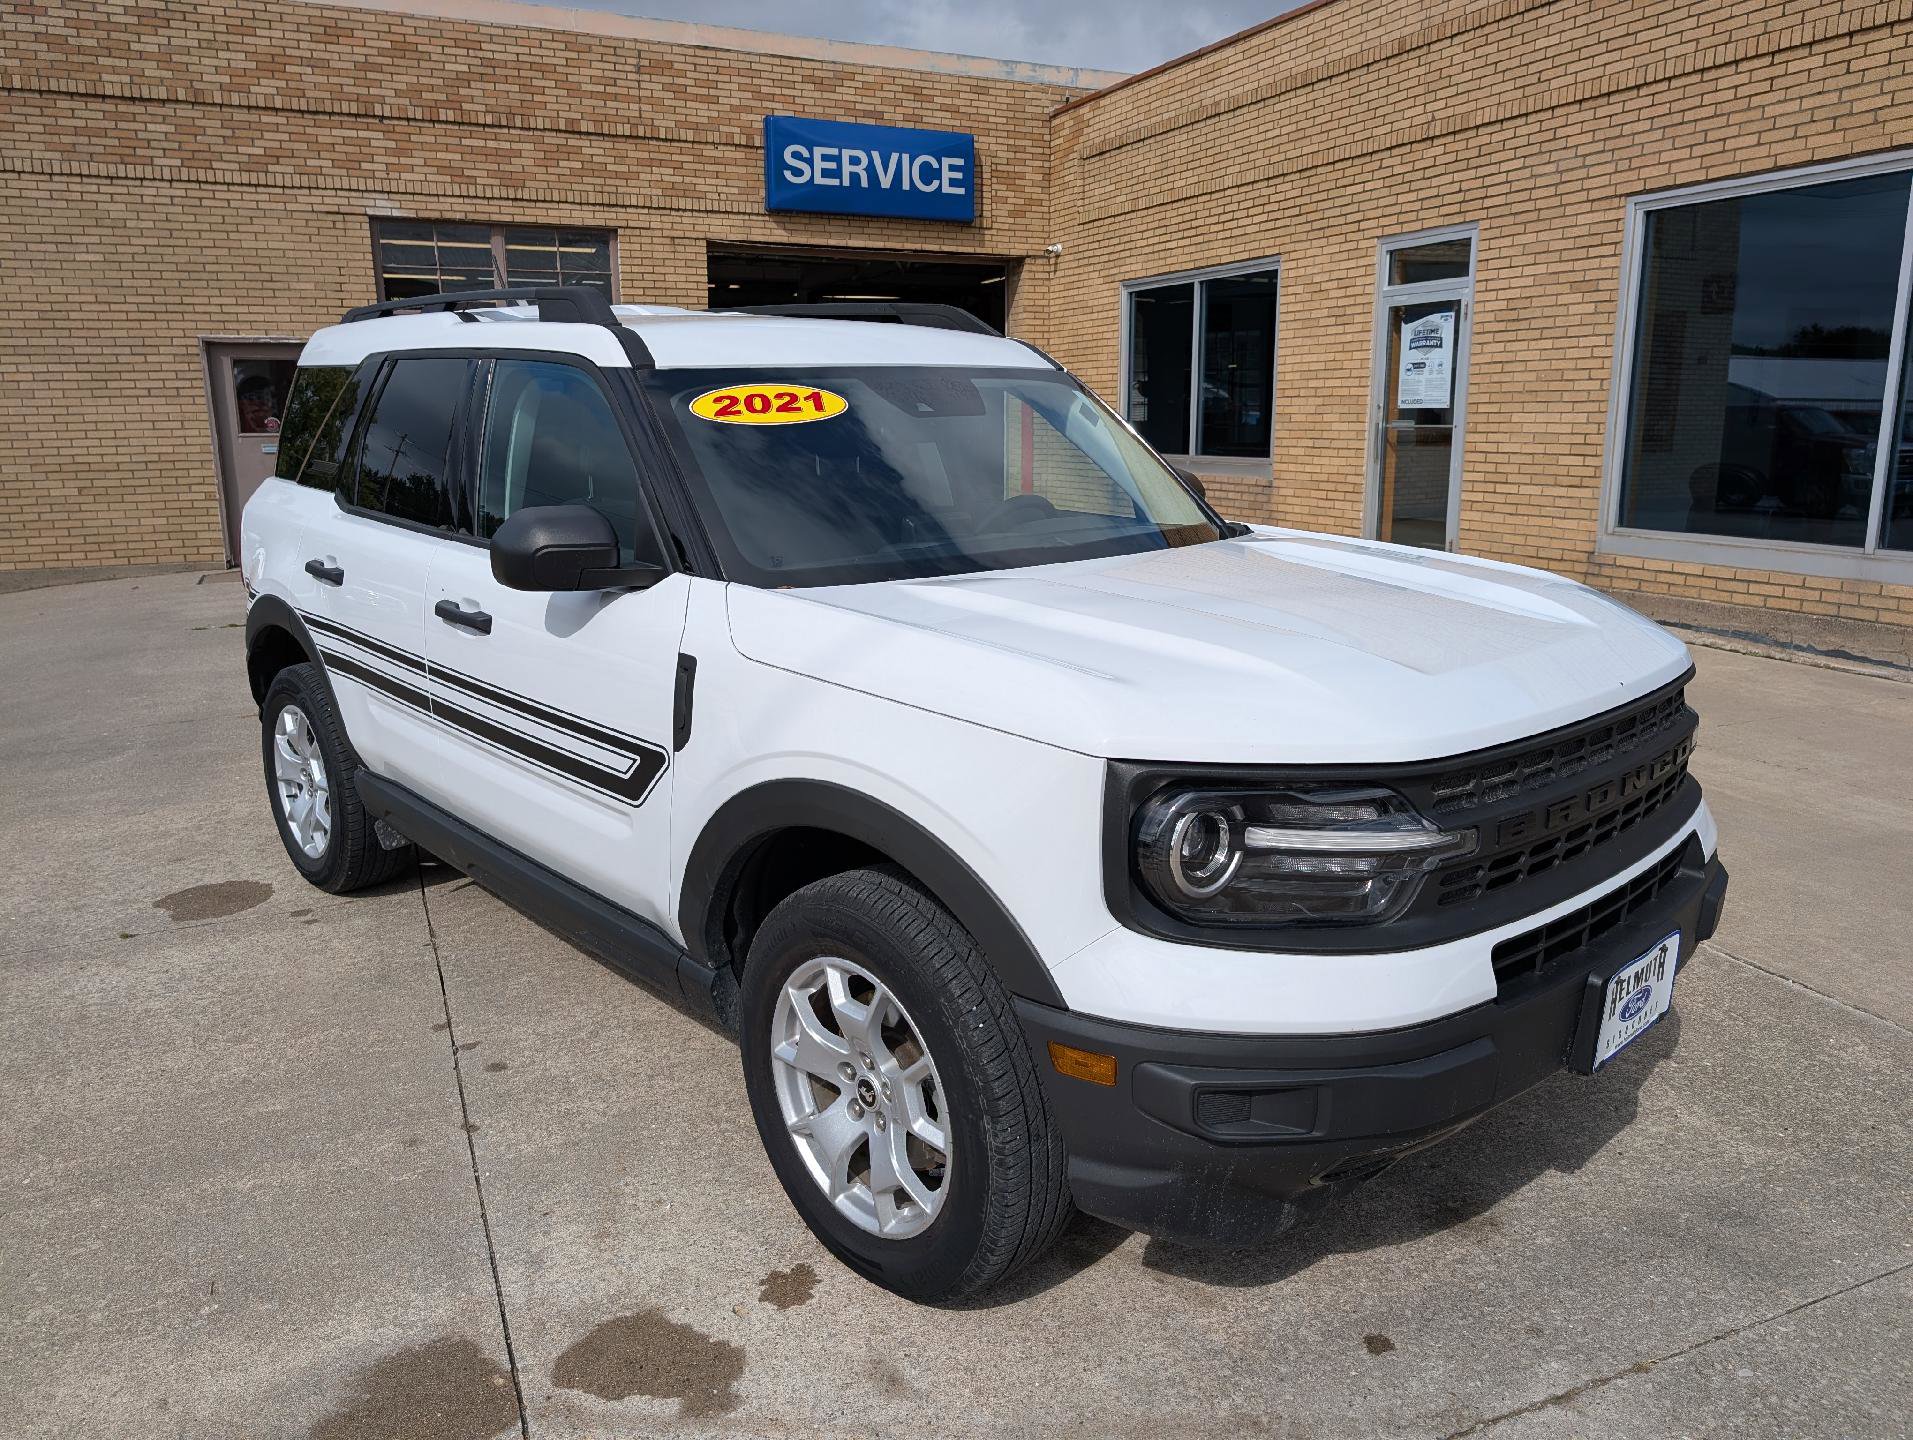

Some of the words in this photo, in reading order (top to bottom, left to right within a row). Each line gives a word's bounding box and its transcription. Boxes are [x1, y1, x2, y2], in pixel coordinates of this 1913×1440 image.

[783, 144, 966, 195] SERVICE
[1410, 339, 1441, 349] WARRANTY
[1412, 328, 1440, 337] LIFETIME
[712, 391, 827, 418] 2021
[1495, 736, 1692, 848] BRONCO
[1607, 944, 1669, 1021] HELMUTH
[1622, 986, 1651, 1020] Ford
